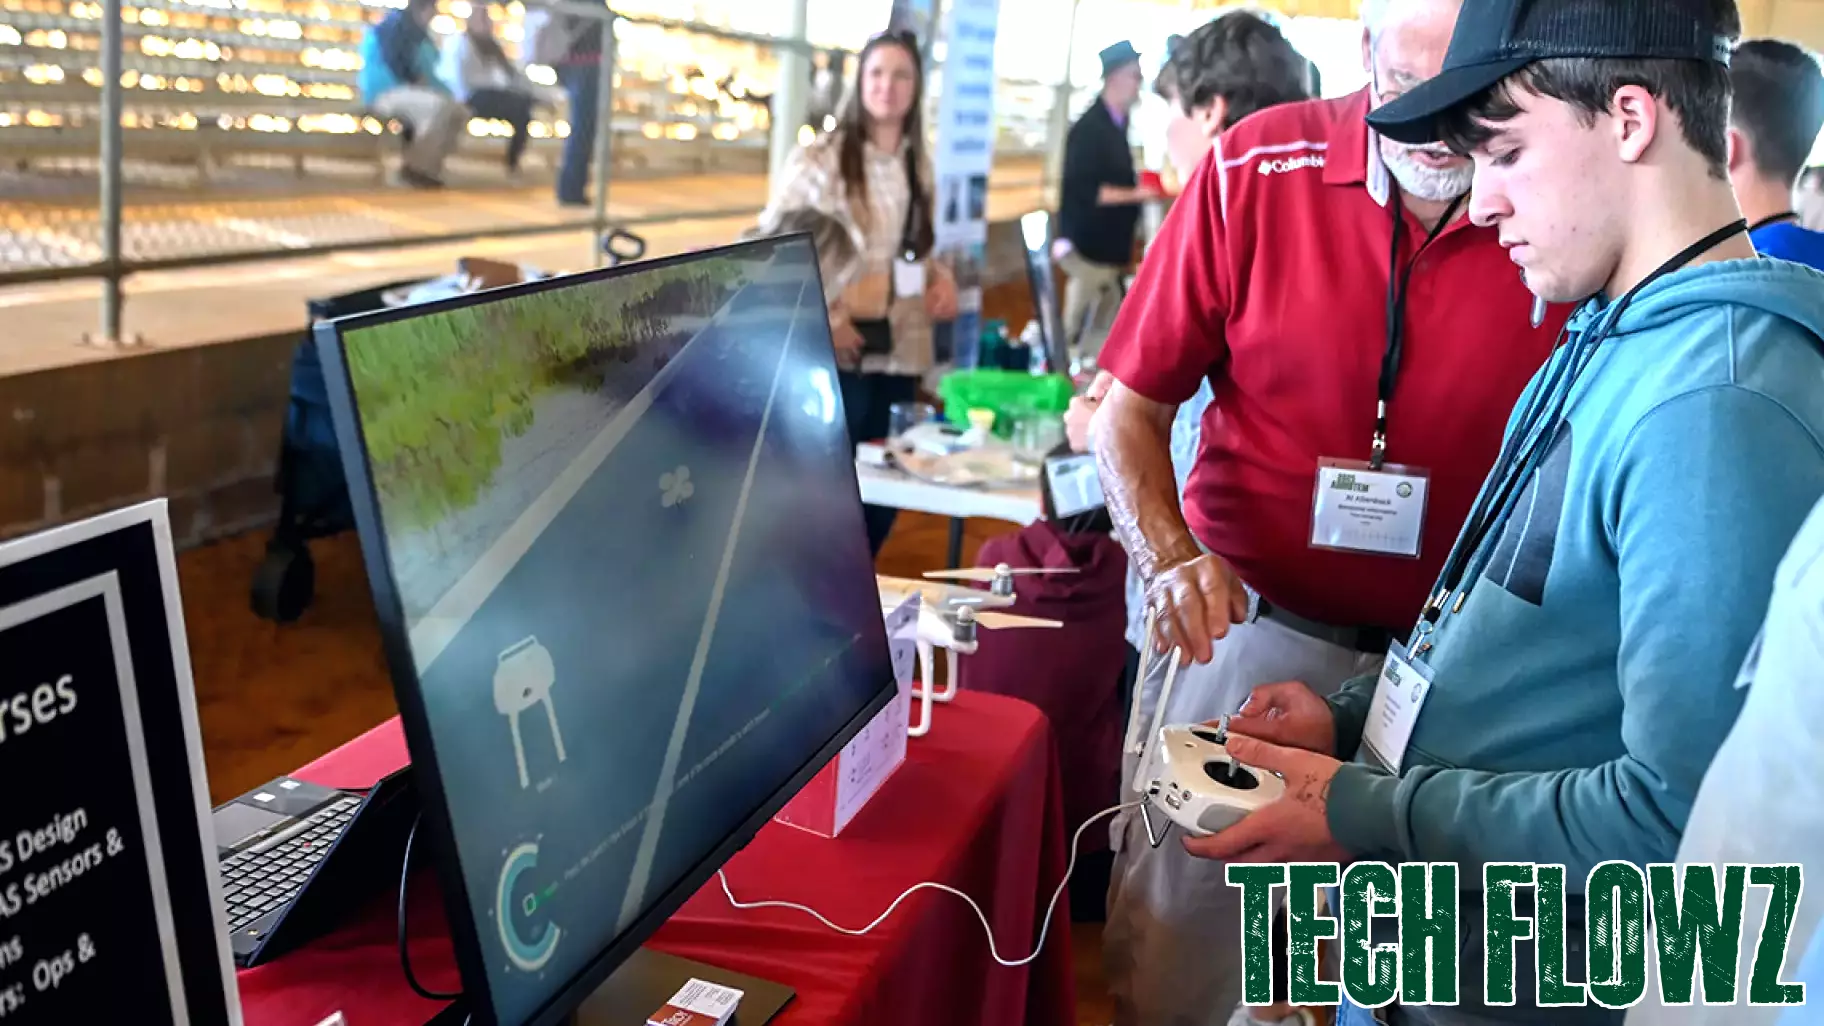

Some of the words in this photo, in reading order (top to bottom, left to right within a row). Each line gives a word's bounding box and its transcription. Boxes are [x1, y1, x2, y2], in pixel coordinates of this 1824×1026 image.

[16, 807, 88, 862] Design
[23, 843, 103, 904] Sensors
[106, 827, 124, 856] &
[32, 949, 75, 991] Ops
[77, 932, 96, 963] &
